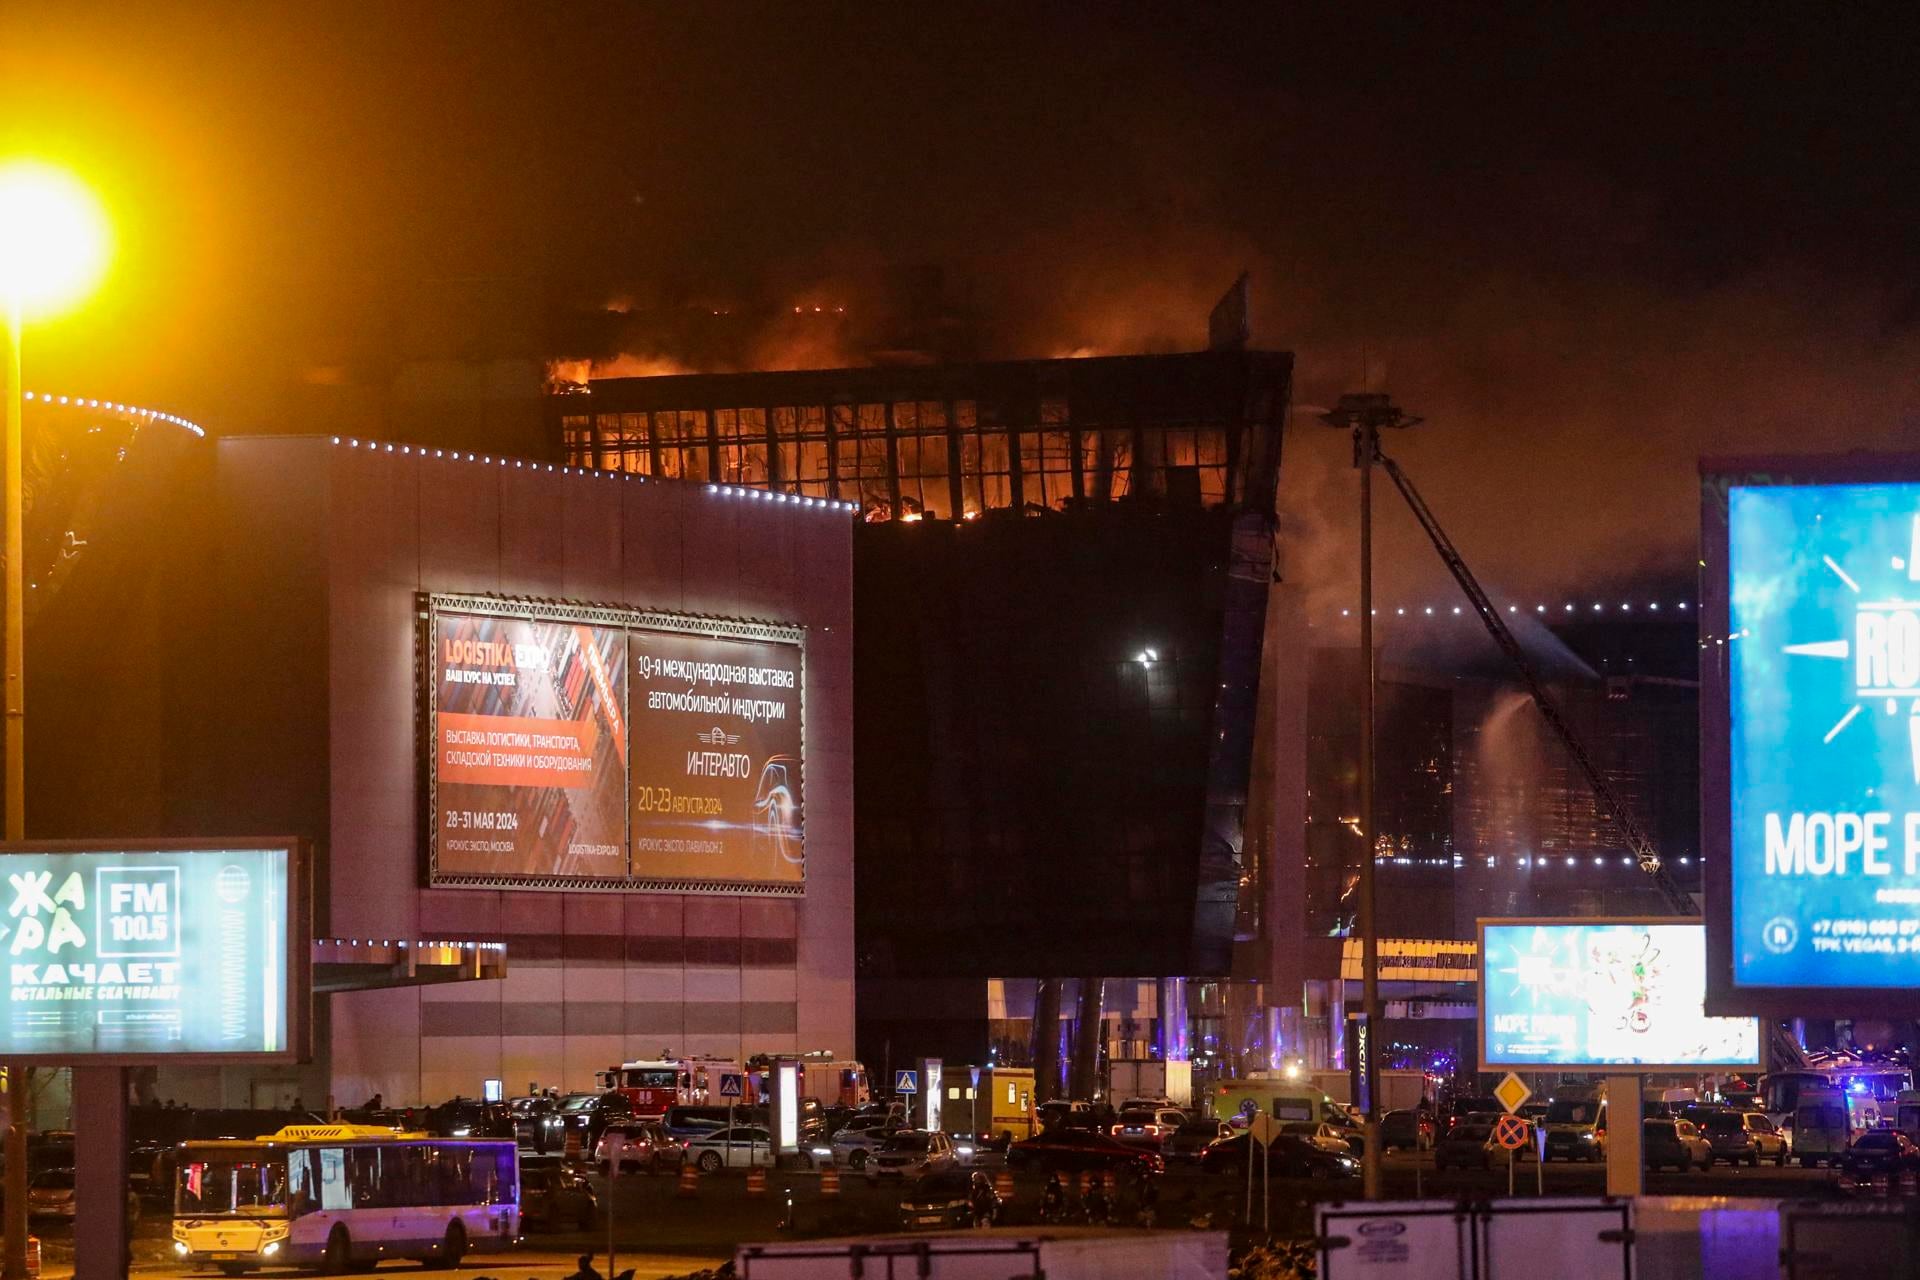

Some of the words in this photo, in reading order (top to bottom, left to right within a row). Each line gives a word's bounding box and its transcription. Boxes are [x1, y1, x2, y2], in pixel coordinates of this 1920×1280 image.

[445, 639, 514, 667] LOGISTIKA
[445, 669, 464, 682] ВАШ
[464, 670, 481, 684] КУРС
[482, 672, 492, 685] НА
[492, 672, 516, 686] УСПЕХ
[638, 656, 661, 679] 19-я
[663, 659, 747, 686] международная
[749, 667, 794, 688] выставка
[648, 689, 730, 715] автомобильной
[732, 697, 785, 723] индустрии
[446, 730, 485, 745] ВЫСТАВКА
[532, 735, 581, 753] ТРАНСПОРТА,
[446, 750, 491, 767] СКЛАДСКОЙ
[493, 753, 526, 768] ТЕХНИКИ
[527, 755, 533, 768] И
[534, 756, 592, 772] ОБОРУДОВАНИЯ
[687, 751, 751, 778] ИНТЕРАВТО
[638, 786, 671, 812] 20-23
[672, 796, 704, 814] АВГУСТА
[704, 798, 723, 814] 2024
[446, 811, 472, 828] 28-31
[473, 812, 495, 829] МАЯ
[496, 812, 518, 830] 2024
[446, 839, 469, 851] КРОКУС
[491, 841, 515, 852] МОСКВА
[638, 838, 663, 851] КРОКУС
[1765, 811, 1890, 875] МОРЕ
[110, 883, 167, 913] FM
[111, 915, 168, 941] 100.5
[11, 963, 181, 985] КАЧАЕТ
[11, 985, 93, 1001] ОСТАЛЬНЫЕ
[1358, 1025, 1367, 1086] ЭКСПО
